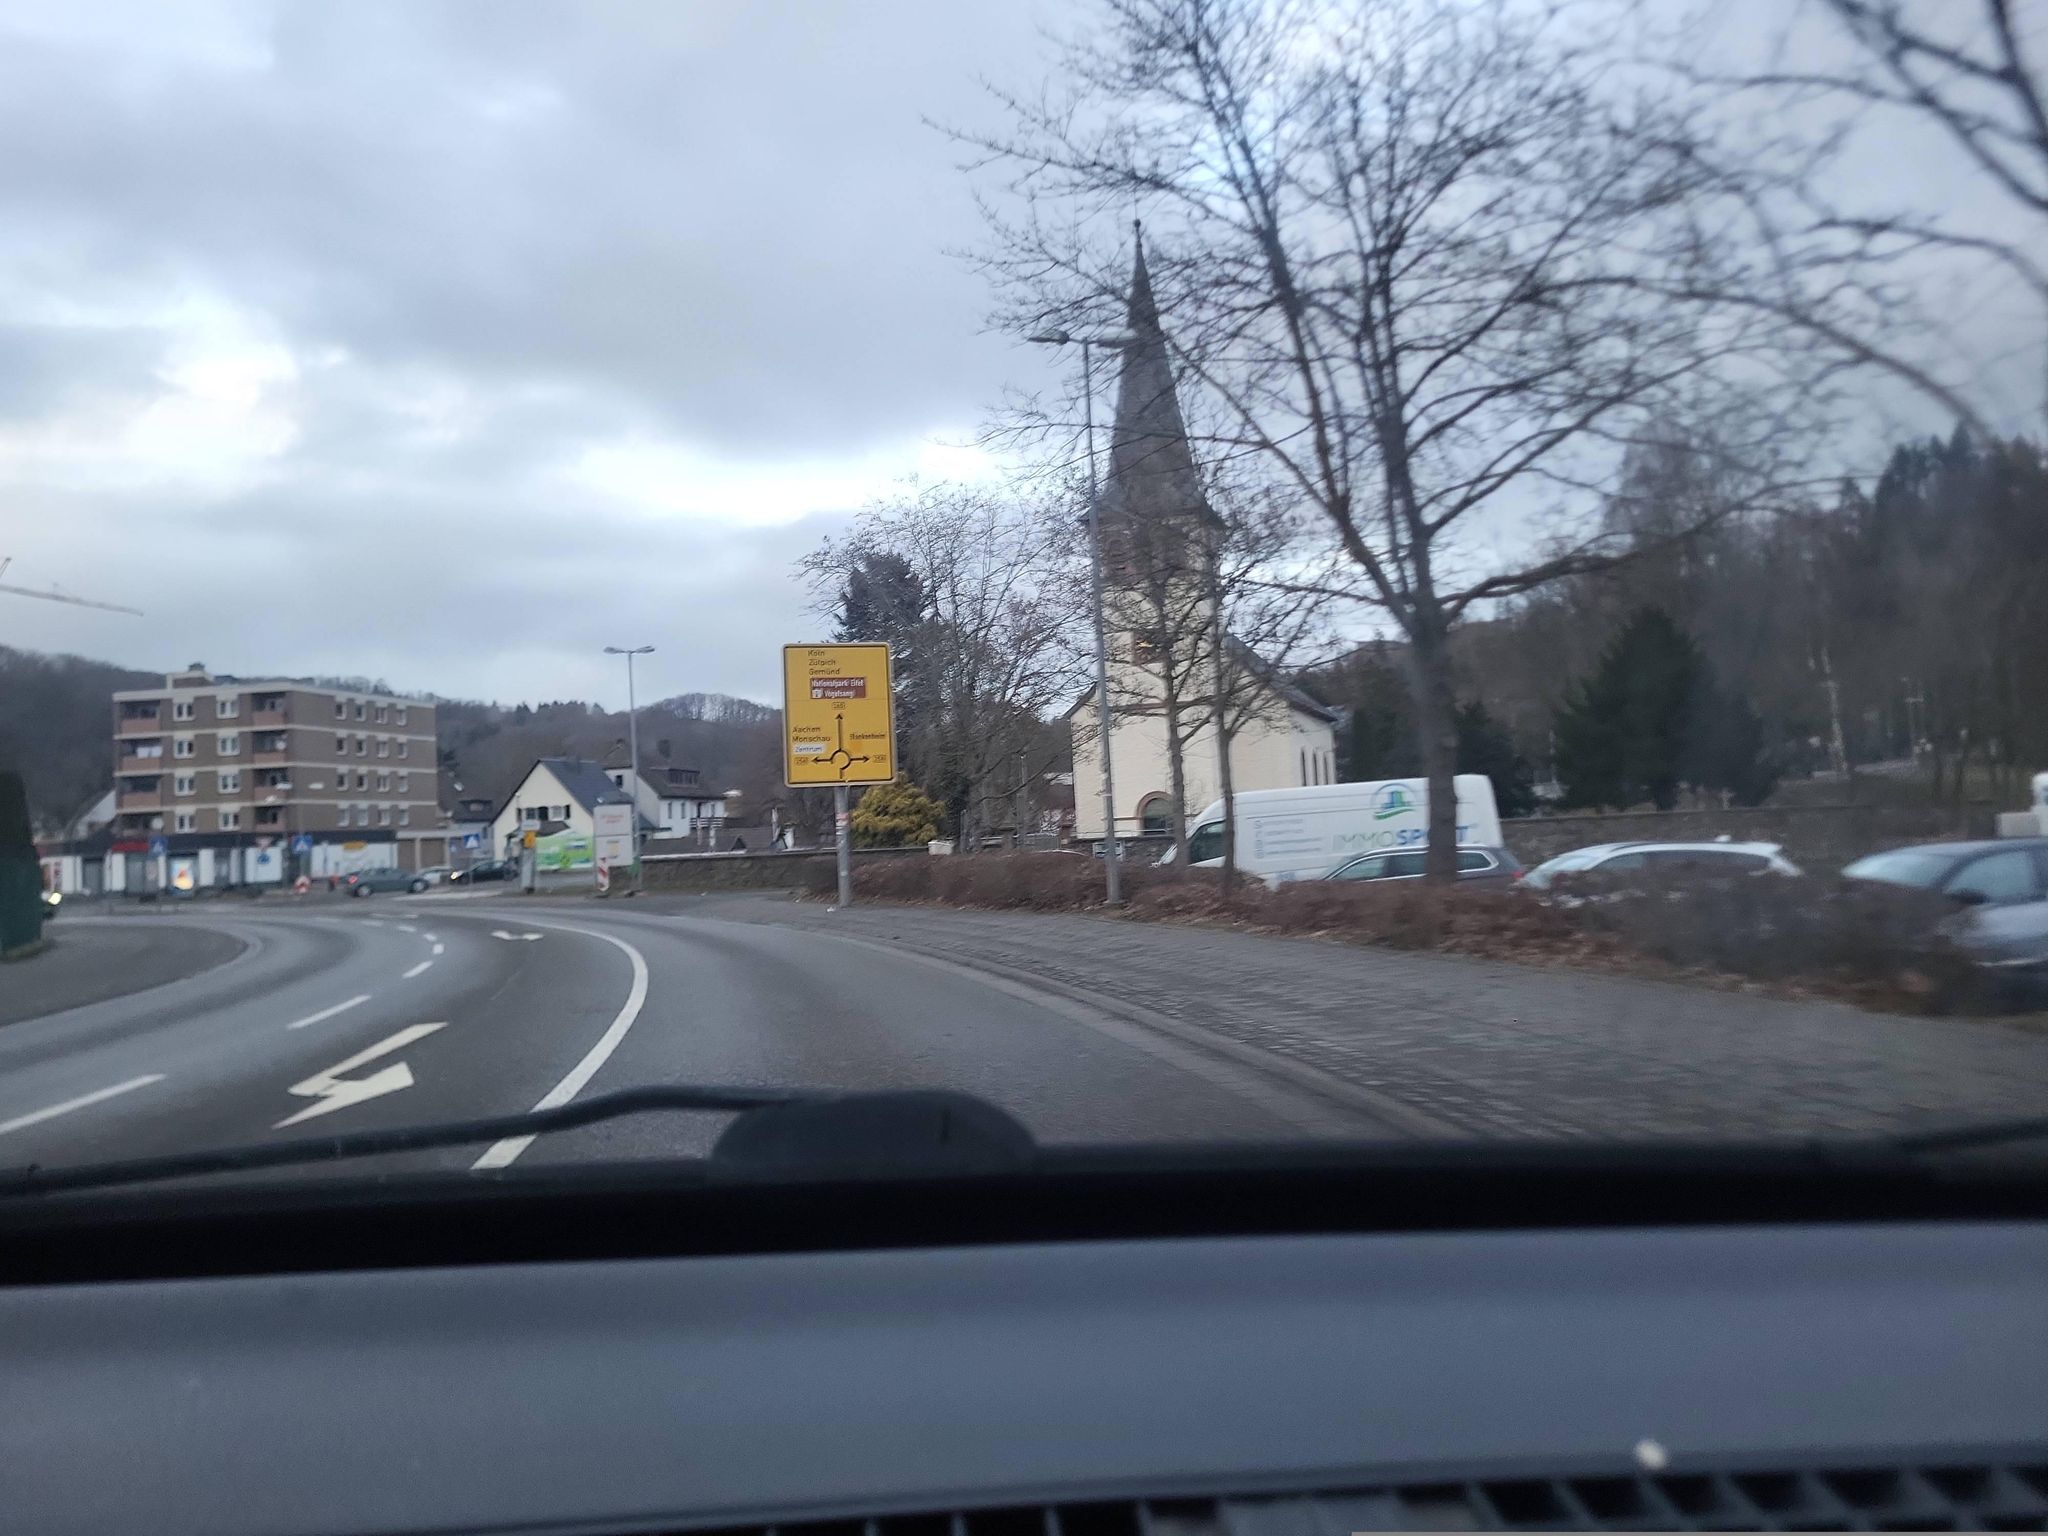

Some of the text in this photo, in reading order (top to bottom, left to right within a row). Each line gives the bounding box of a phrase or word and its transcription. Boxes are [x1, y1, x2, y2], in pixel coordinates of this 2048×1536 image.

[808, 649, 825, 657] Köln
[808, 658, 836, 667] Zülpich
[811, 678, 864, 688] Nationalpark Eifel
[792, 726, 821, 734] Aachen
[792, 735, 831, 743] Monschau
[794, 745, 823, 753] Zentrum
[1333, 825, 1469, 851] IMMOSPT
